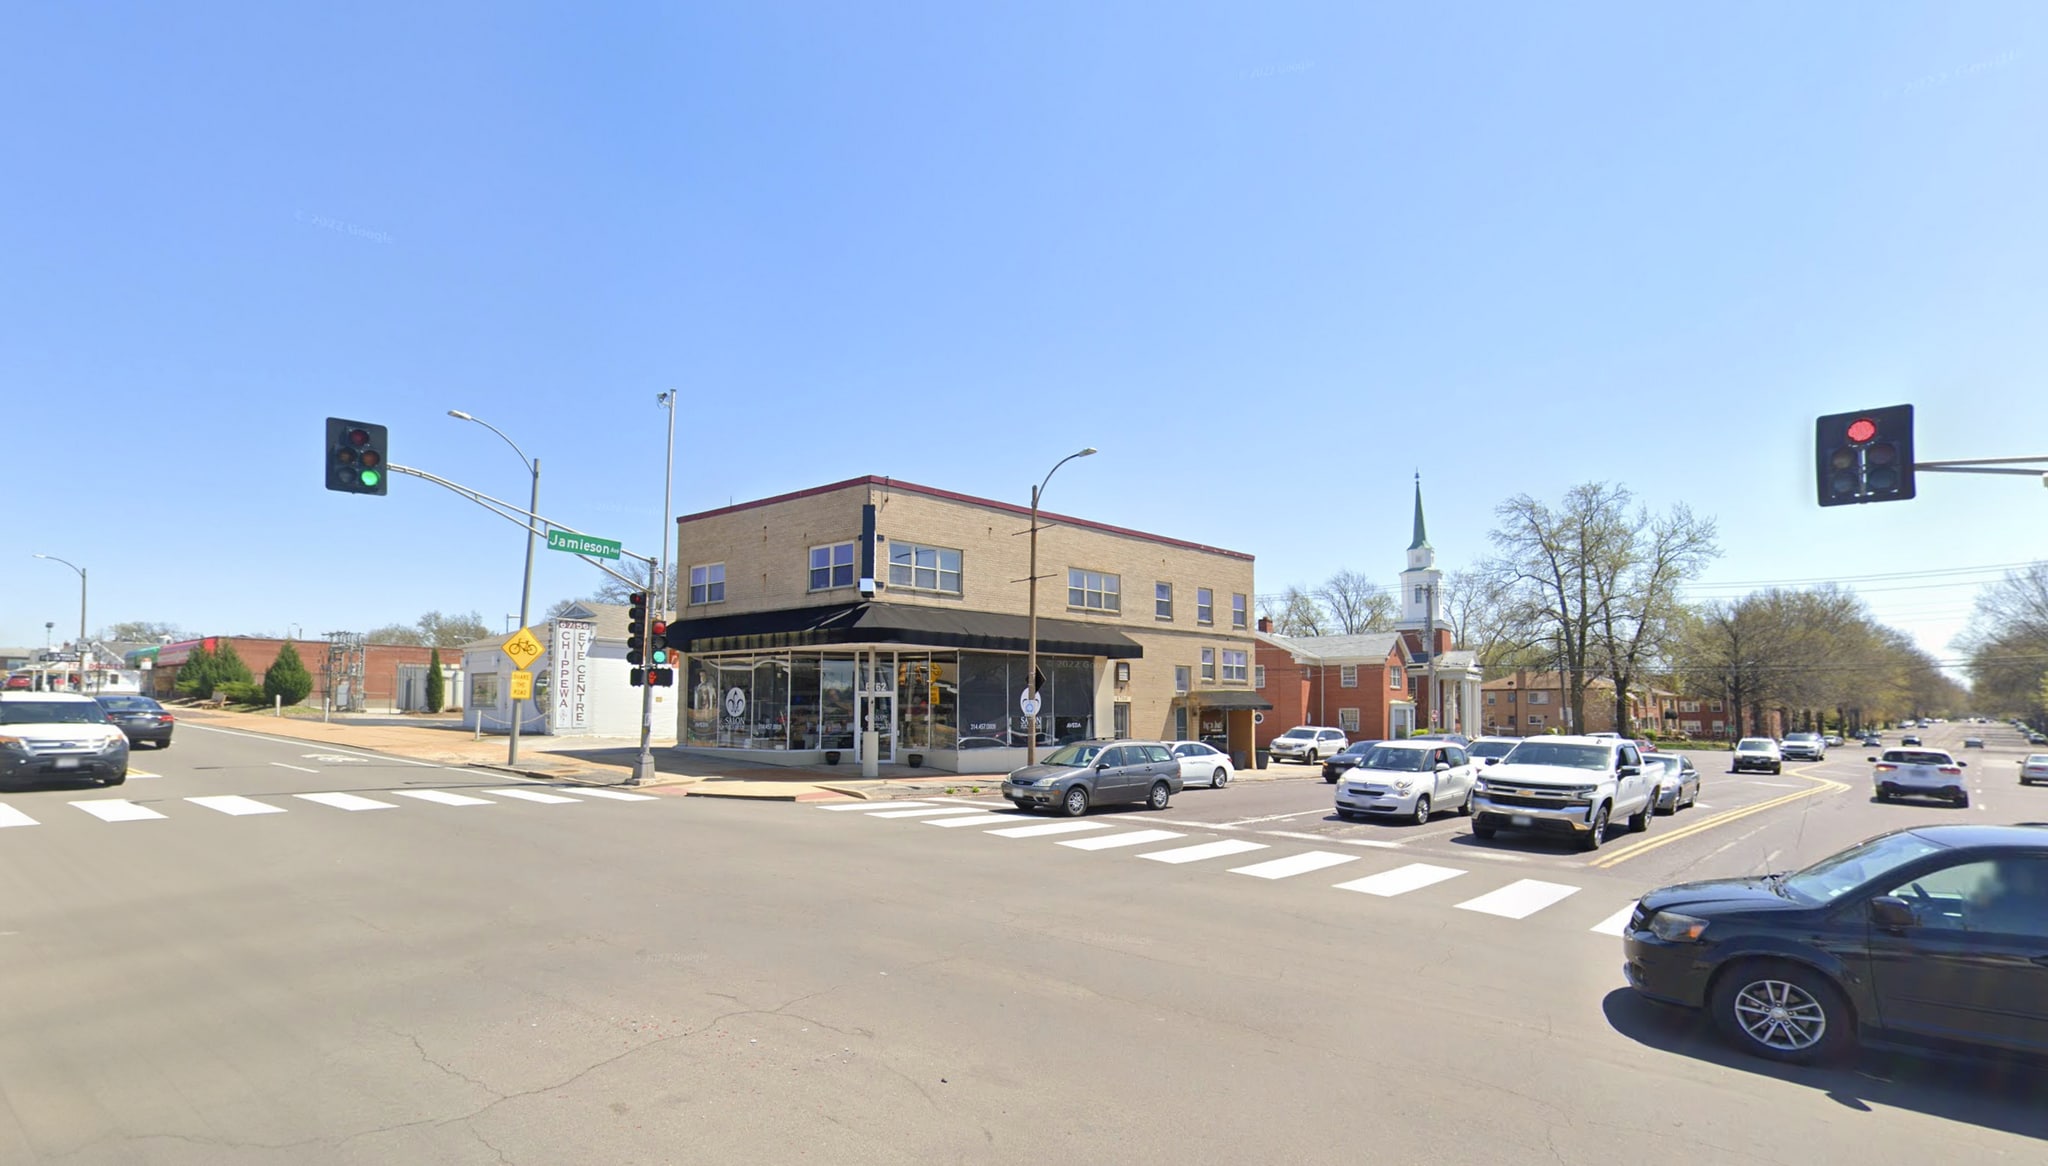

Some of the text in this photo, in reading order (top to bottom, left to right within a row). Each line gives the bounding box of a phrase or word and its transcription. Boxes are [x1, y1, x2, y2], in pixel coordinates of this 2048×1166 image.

[549, 534, 610, 555] Jamieson
[559, 631, 571, 708] CHIPPEWA
[576, 633, 586, 722] EYE CENTRE
